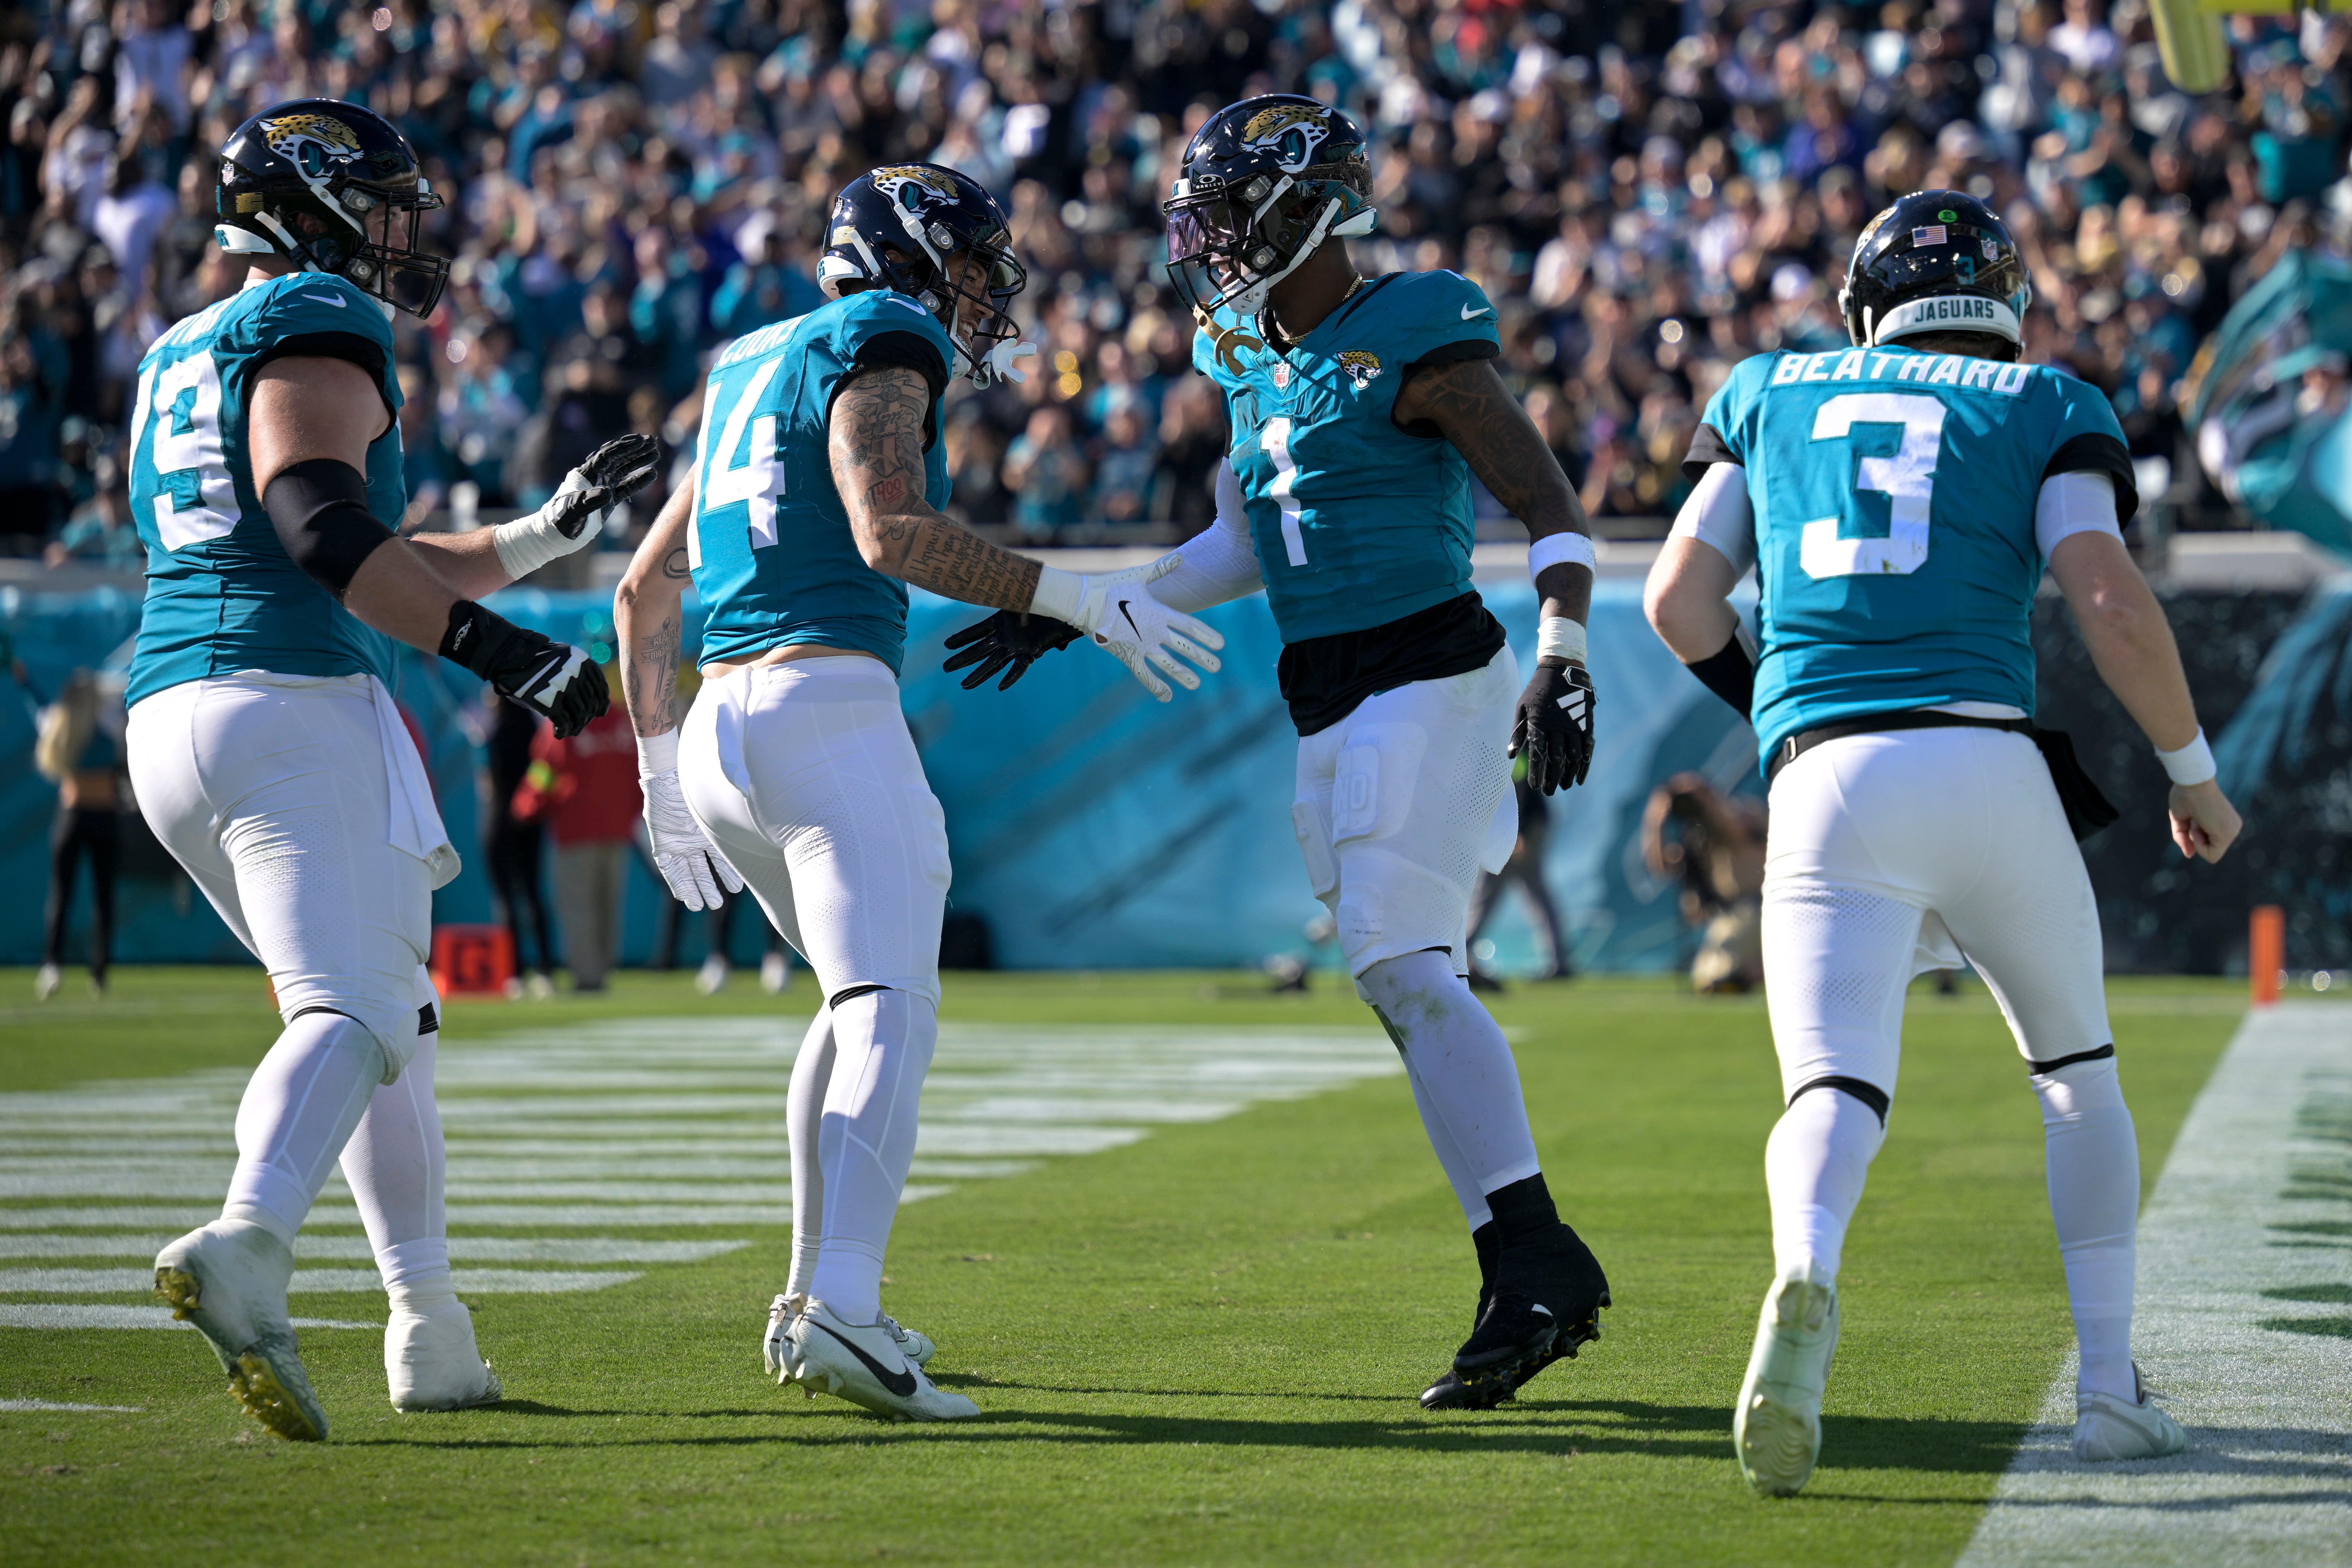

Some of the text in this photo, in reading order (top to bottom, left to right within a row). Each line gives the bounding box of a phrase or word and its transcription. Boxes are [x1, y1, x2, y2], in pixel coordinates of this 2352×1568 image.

[1956, 256, 1975, 285] 3
[1915, 299, 1994, 323] JAGUARS
[1276, 374, 1287, 384] NFL
[1772, 351, 2033, 395] BEATHARD
[1261, 416, 1308, 567] 1
[1800, 392, 1949, 575] 3
[912, 530, 940, 567] know
